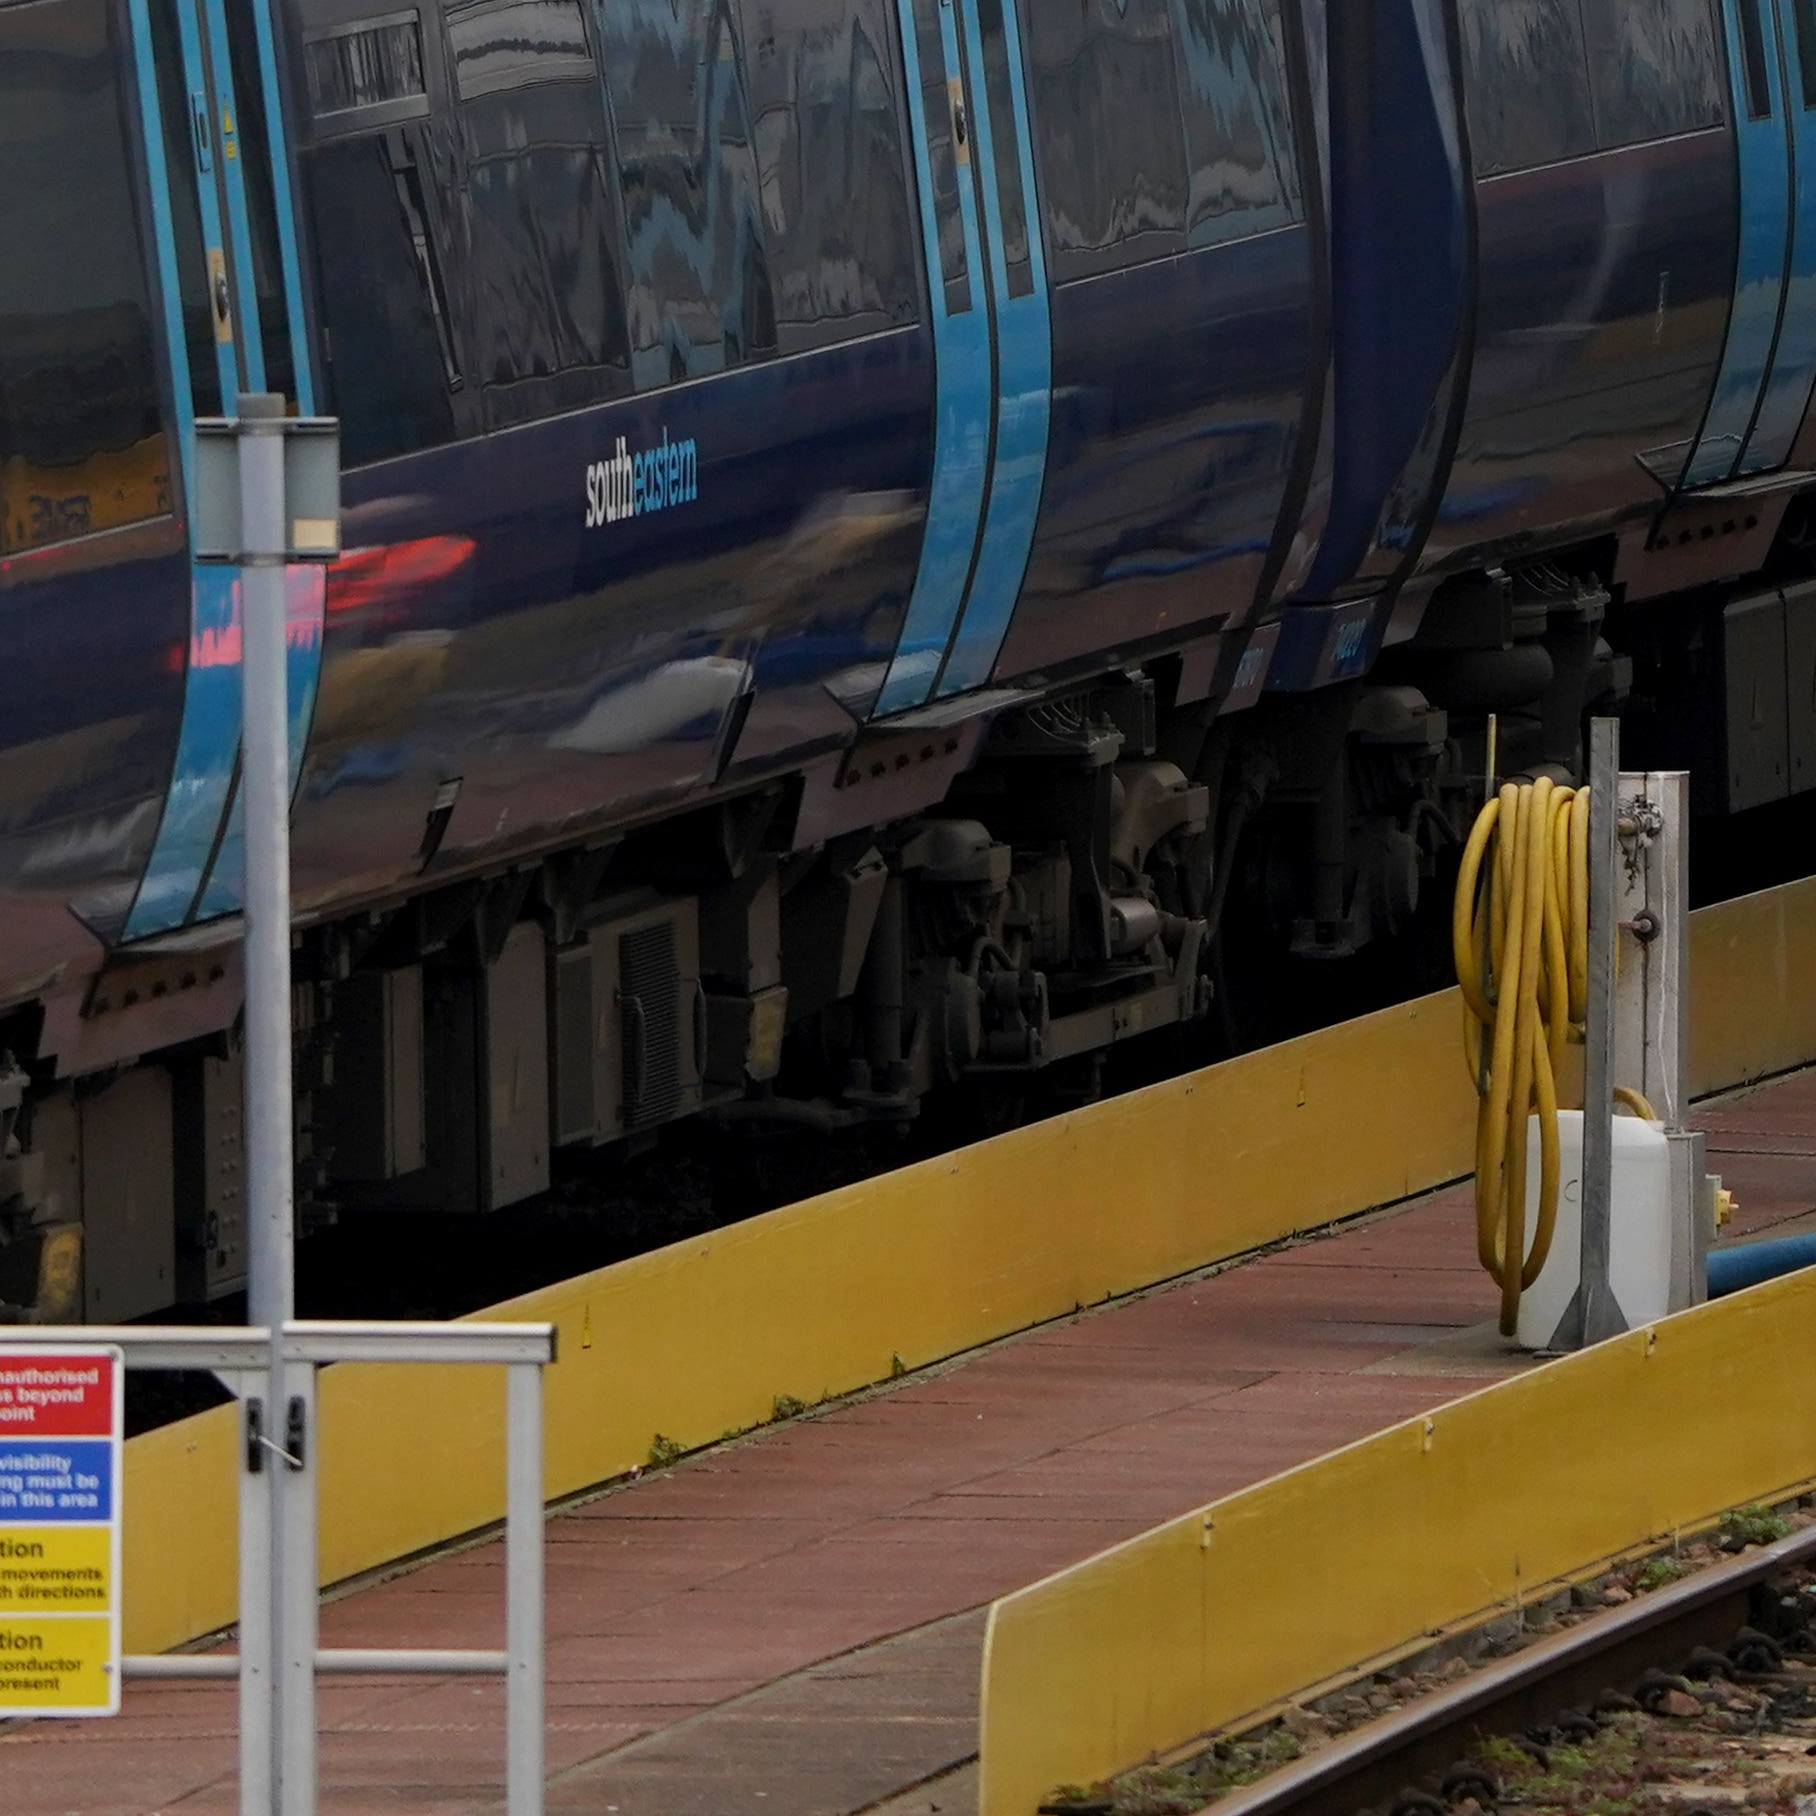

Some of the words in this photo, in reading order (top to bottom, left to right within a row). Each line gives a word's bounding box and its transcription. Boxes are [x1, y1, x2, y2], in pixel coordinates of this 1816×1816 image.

[585, 425, 697, 528] southeastern
[17, 1386, 84, 1407] beyond
[26, 1473, 73, 1489] must
[75, 1472, 100, 1490] be
[0, 1491, 17, 1508] in
[20, 1491, 56, 1508] this
[58, 1493, 99, 1508] area
[1, 1568, 103, 1581] movements
[19, 1585, 106, 1600] directions
